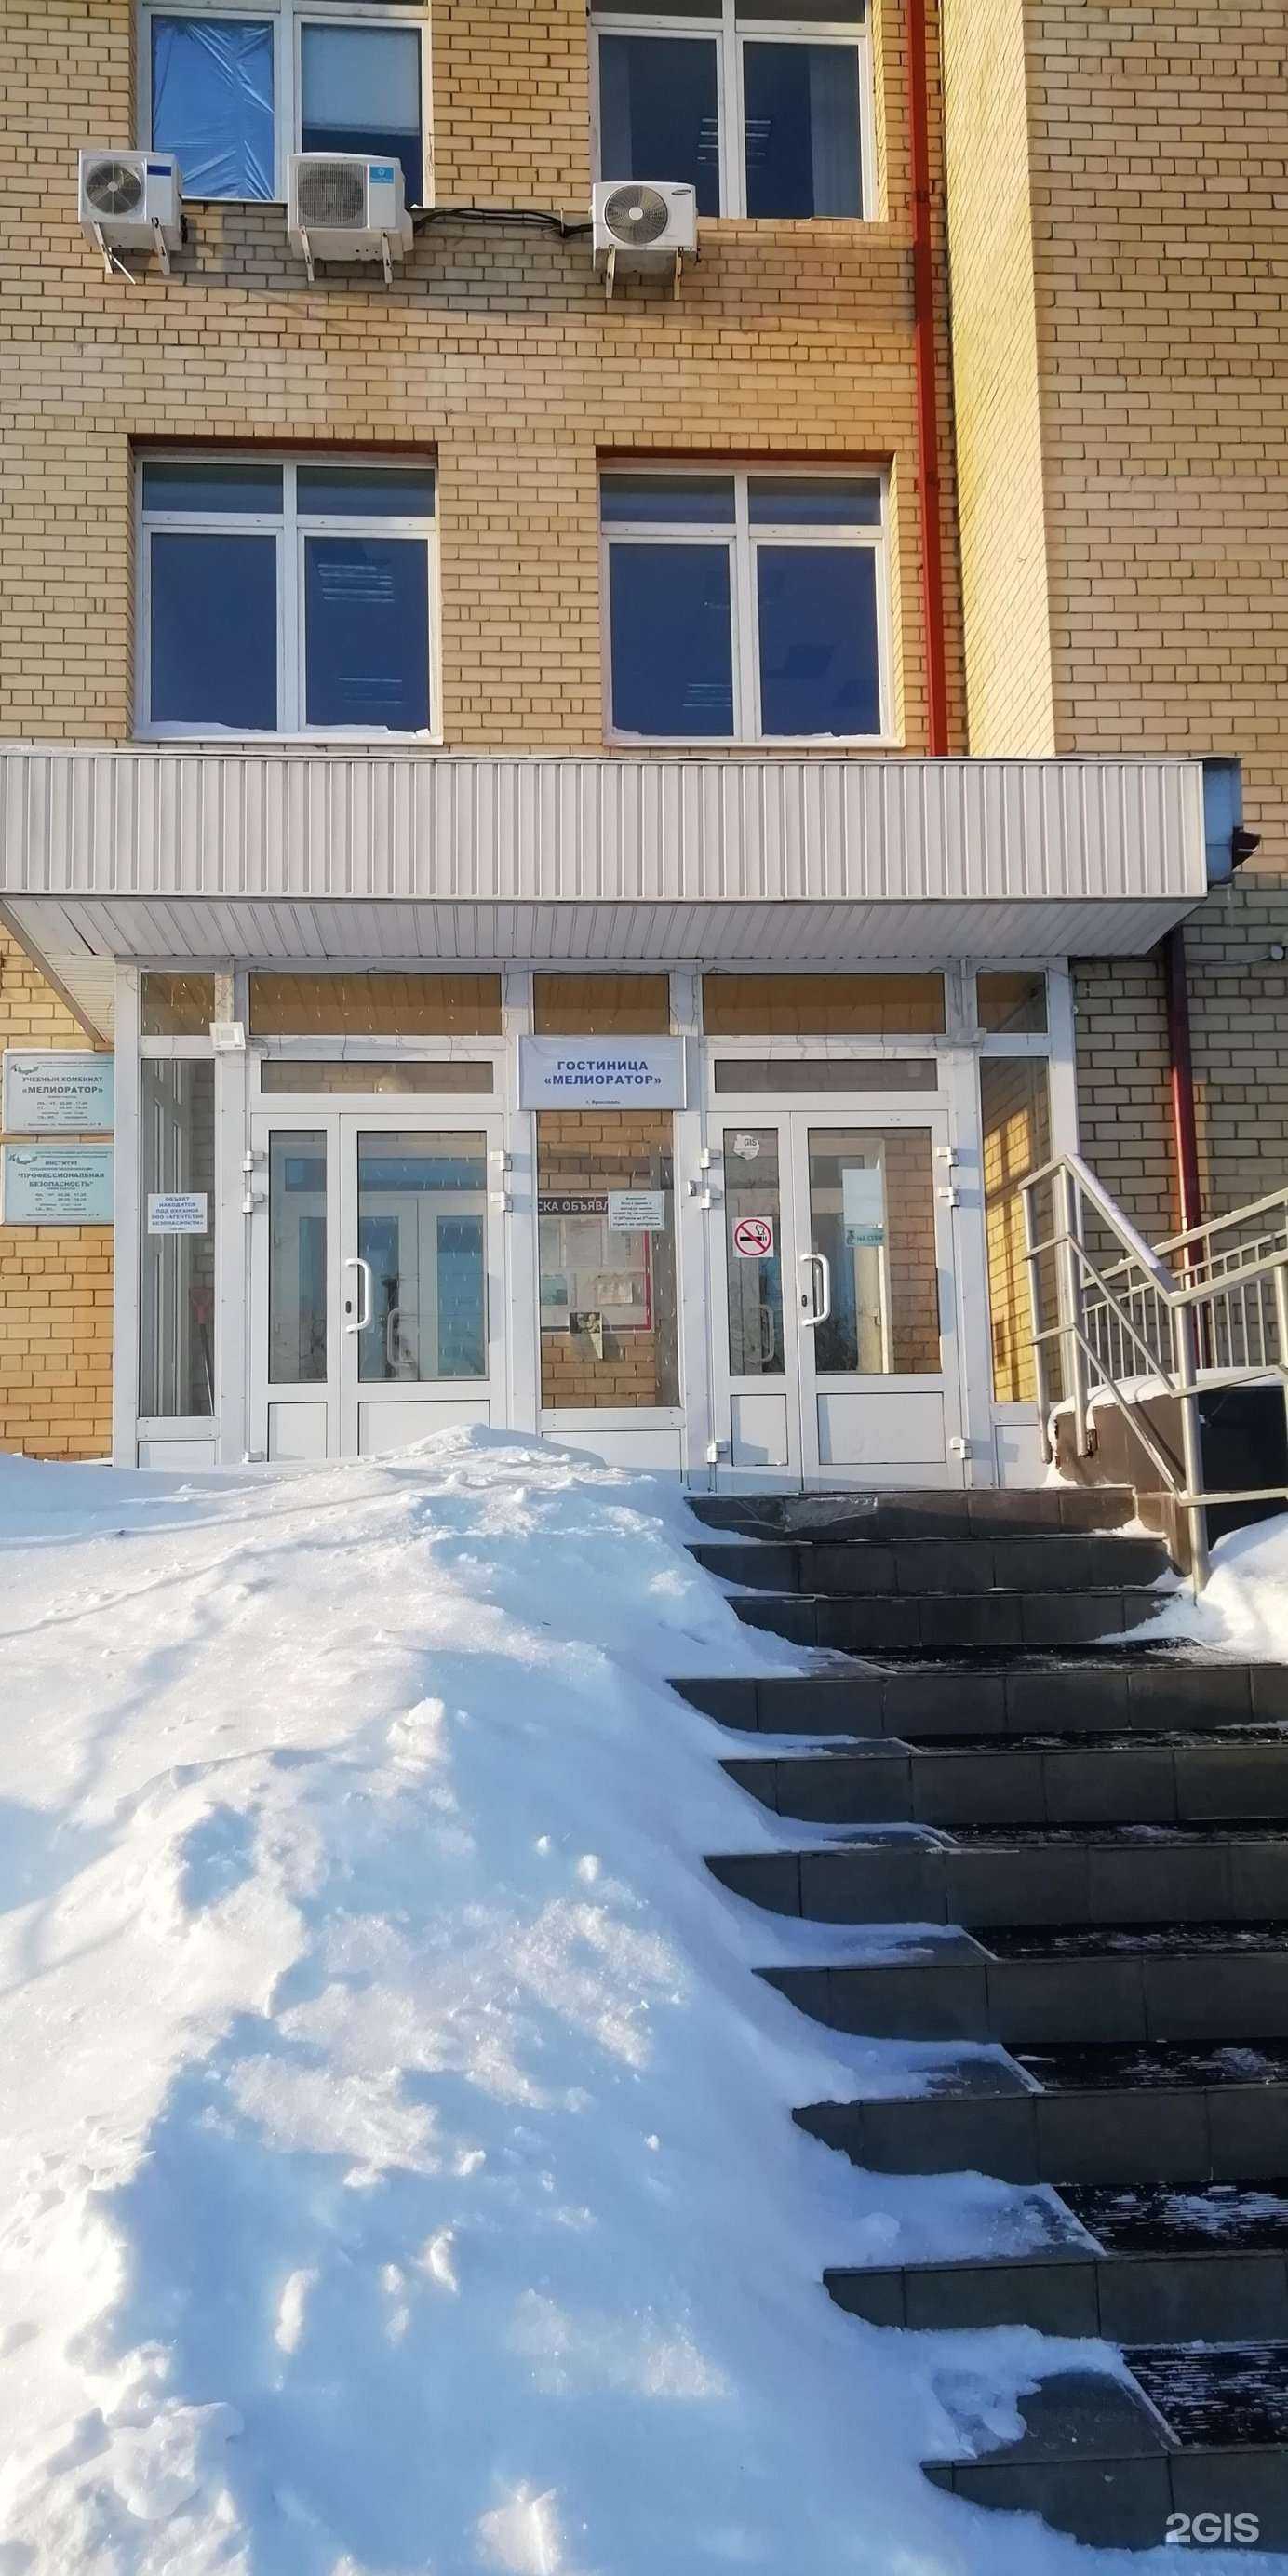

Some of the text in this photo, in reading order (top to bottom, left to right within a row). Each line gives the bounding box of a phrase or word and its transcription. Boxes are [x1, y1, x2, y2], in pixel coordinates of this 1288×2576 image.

[557, 1061, 648, 1072] ГОСТИНИЦА
[544, 1075, 662, 1085] «МЕЛИОРАТОР»
[562, 1201, 609, 1211] ОБЪЯВЛ
